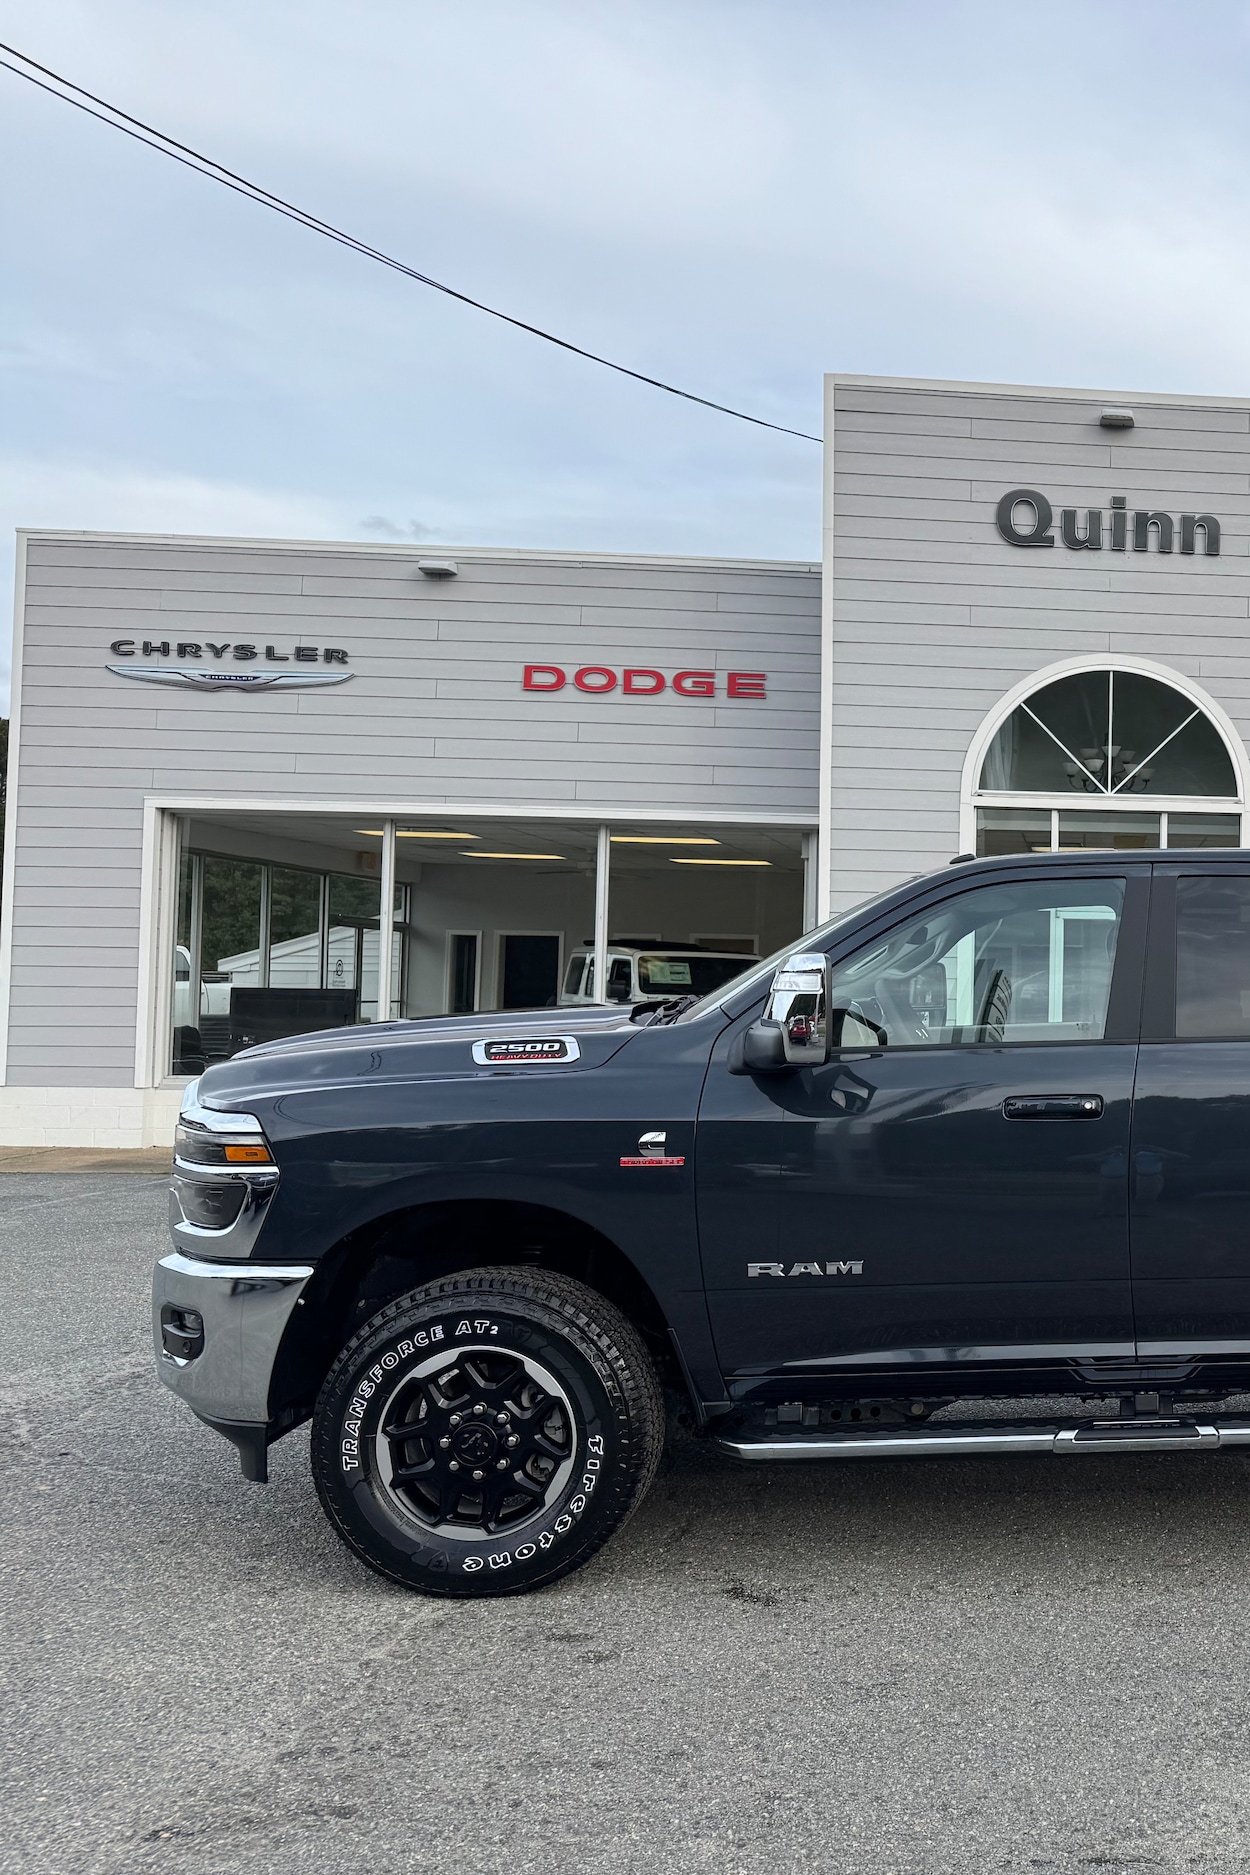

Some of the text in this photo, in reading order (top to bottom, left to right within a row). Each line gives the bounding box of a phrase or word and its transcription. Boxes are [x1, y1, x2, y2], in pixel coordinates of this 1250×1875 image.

[996, 488, 1221, 556] Quinn
[110, 639, 349, 664] CHRYSLER
[522, 665, 767, 699] DODGE
[489, 1043, 561, 1054] 2500
[747, 1260, 864, 1277] RAM
[342, 1325, 445, 1471] TRANSFORCE
[462, 1435, 604, 1572] Firestone
